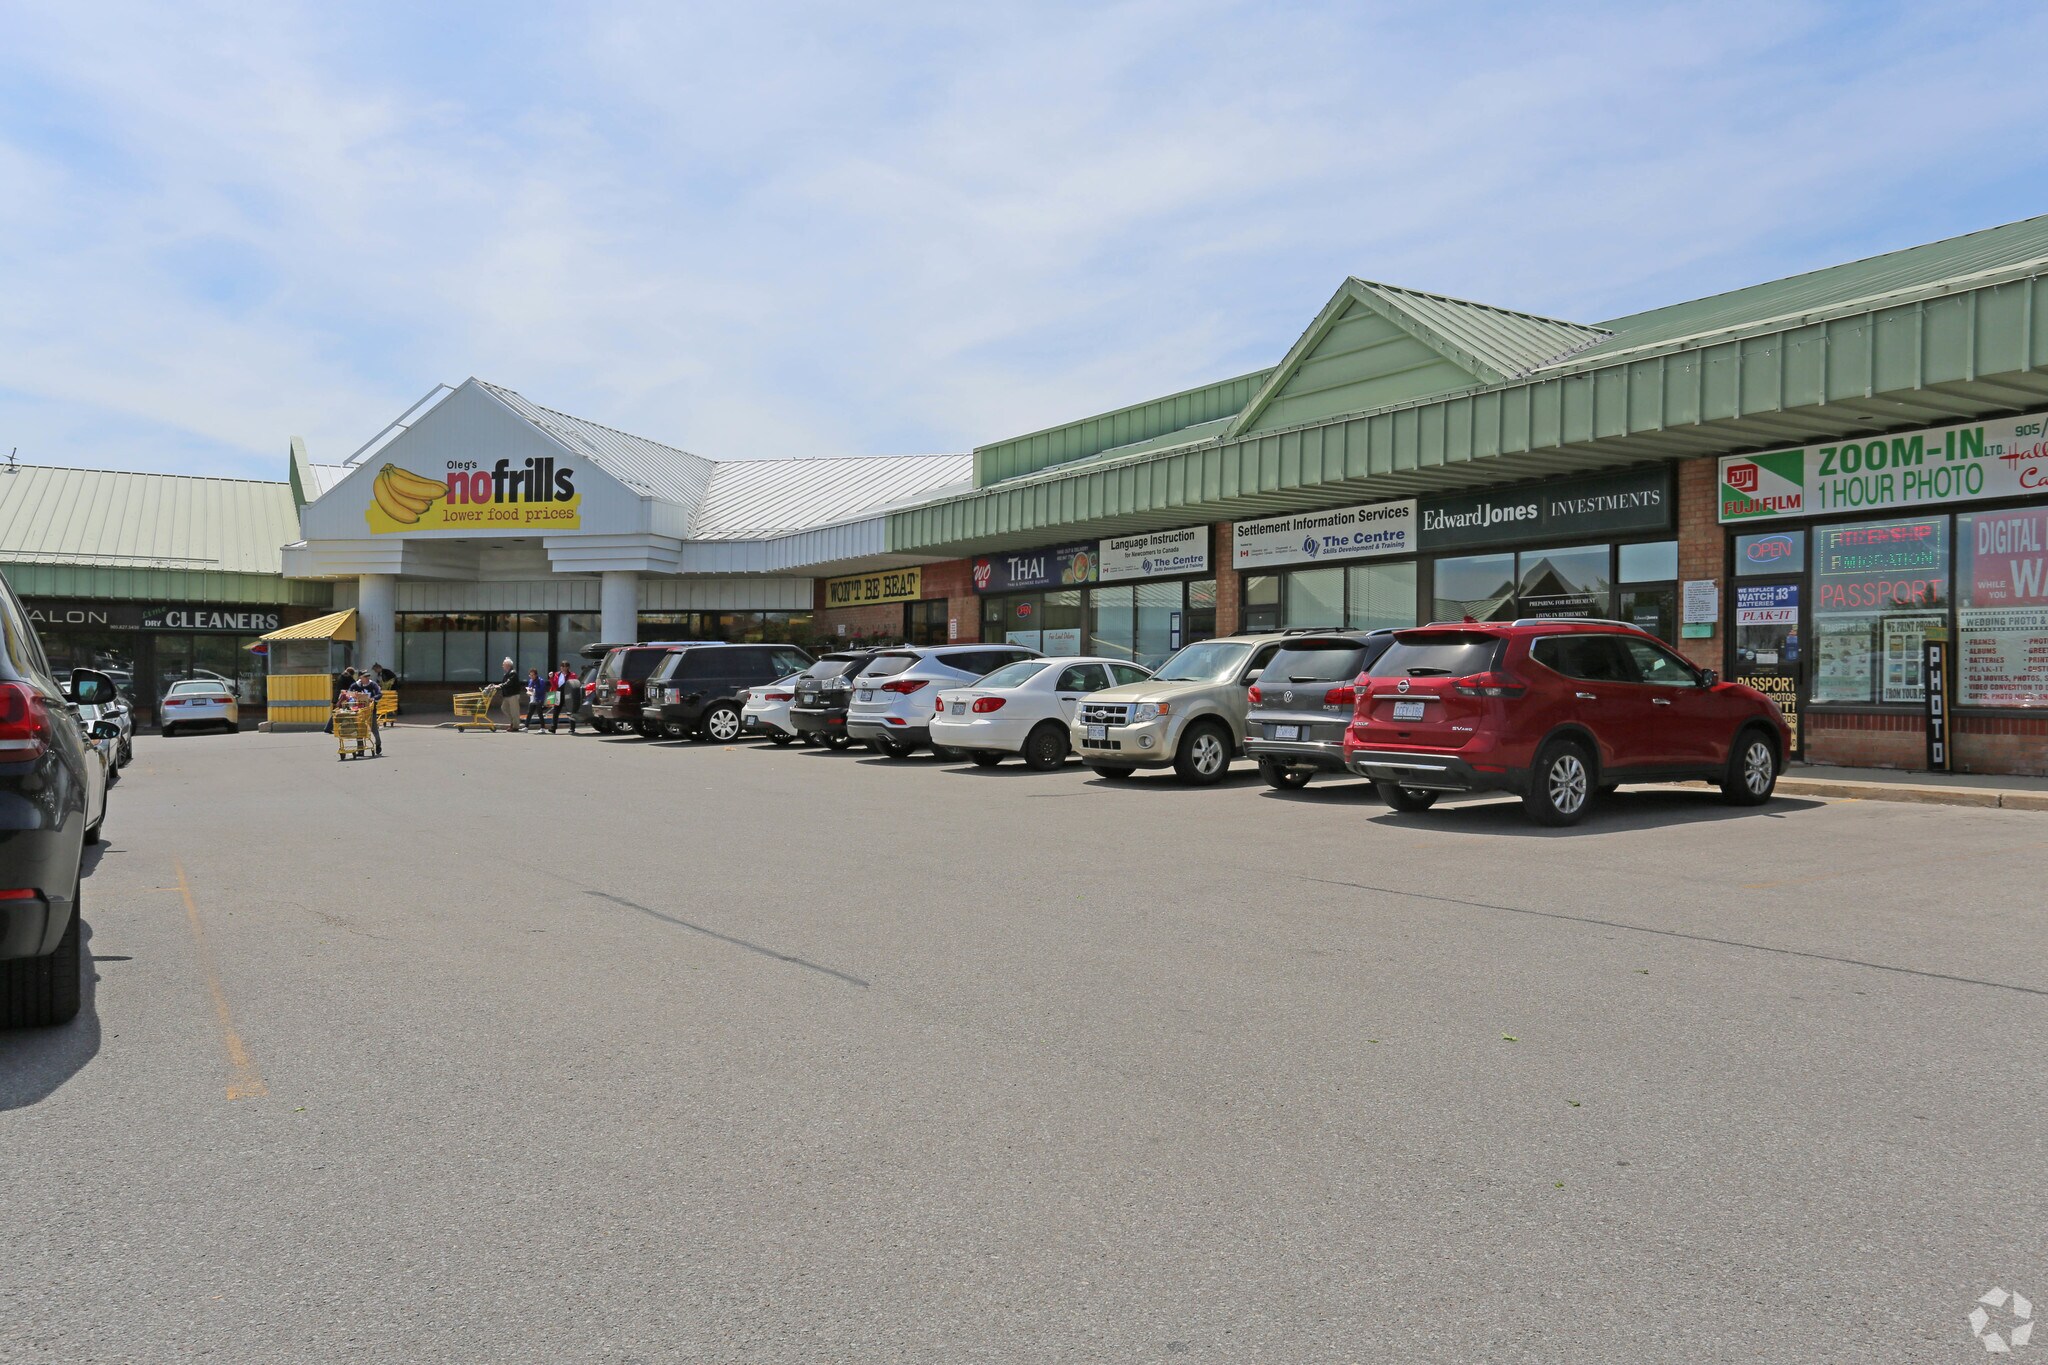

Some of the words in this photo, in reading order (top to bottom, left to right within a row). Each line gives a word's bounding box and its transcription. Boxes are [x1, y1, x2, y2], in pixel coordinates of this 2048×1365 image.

[1819, 427, 1984, 476] ZOOM-IN
[1984, 444, 2006, 457] LTD.
[1999, 441, 2048, 471] Hall
[446, 460, 478, 470] Oleg's
[2019, 466, 2048, 489] Ca
[1819, 481, 1826, 509] 1
[1833, 473, 1895, 508] HOUR
[1903, 463, 1984, 501] PHOTO
[1551, 489, 1661, 517] INVESTMENTS
[1724, 493, 1801, 515] FUJIFILM
[443, 509, 484, 522] lower
[487, 508, 519, 521] food
[525, 507, 575, 523] prices
[1237, 519, 1290, 537] Settlement
[1293, 512, 1355, 531] Information
[1358, 505, 1409, 522] Services
[1110, 537, 1148, 551] Language
[1150, 530, 1195, 546] Instruction
[1322, 535, 1349, 547] The
[1353, 530, 1405, 544] Centre
[1978, 518, 2041, 555] DIGITAL
[1131, 549, 1156, 557] Newcomers
[1162, 546, 1179, 554] Canada
[1338, 544, 1374, 553] Development
[1381, 541, 1405, 549] Training
[1747, 542, 1792, 558] OPEN
[1007, 557, 1045, 580] THAI
[1154, 558, 1170, 567] The
[1172, 555, 1204, 565] Centre
[830, 579, 861, 602] WON'T
[864, 577, 880, 600] BE
[883, 572, 916, 597] BEAT
[1978, 580, 2006, 589] WHILE
[1738, 593, 1774, 601] WATCH
[1821, 580, 1943, 608] PASSPORT
[1989, 591, 2006, 599] YOU
[29, 610, 107, 624] ALON
[166, 611, 279, 630] CLEANERS
[1743, 610, 1792, 621] PLAK-IT
[2009, 616, 2037, 625] PHOTO
[2041, 616, 2047, 624] &
[1886, 621, 1895, 633] WE
[1896, 621, 1915, 633] PRINT
[1969, 656, 2005, 664] BATTERIES
[1886, 688, 1900, 699] FROM
[1902, 688, 1917, 699] YOUR
[1929, 646, 1944, 763] PHOTO
